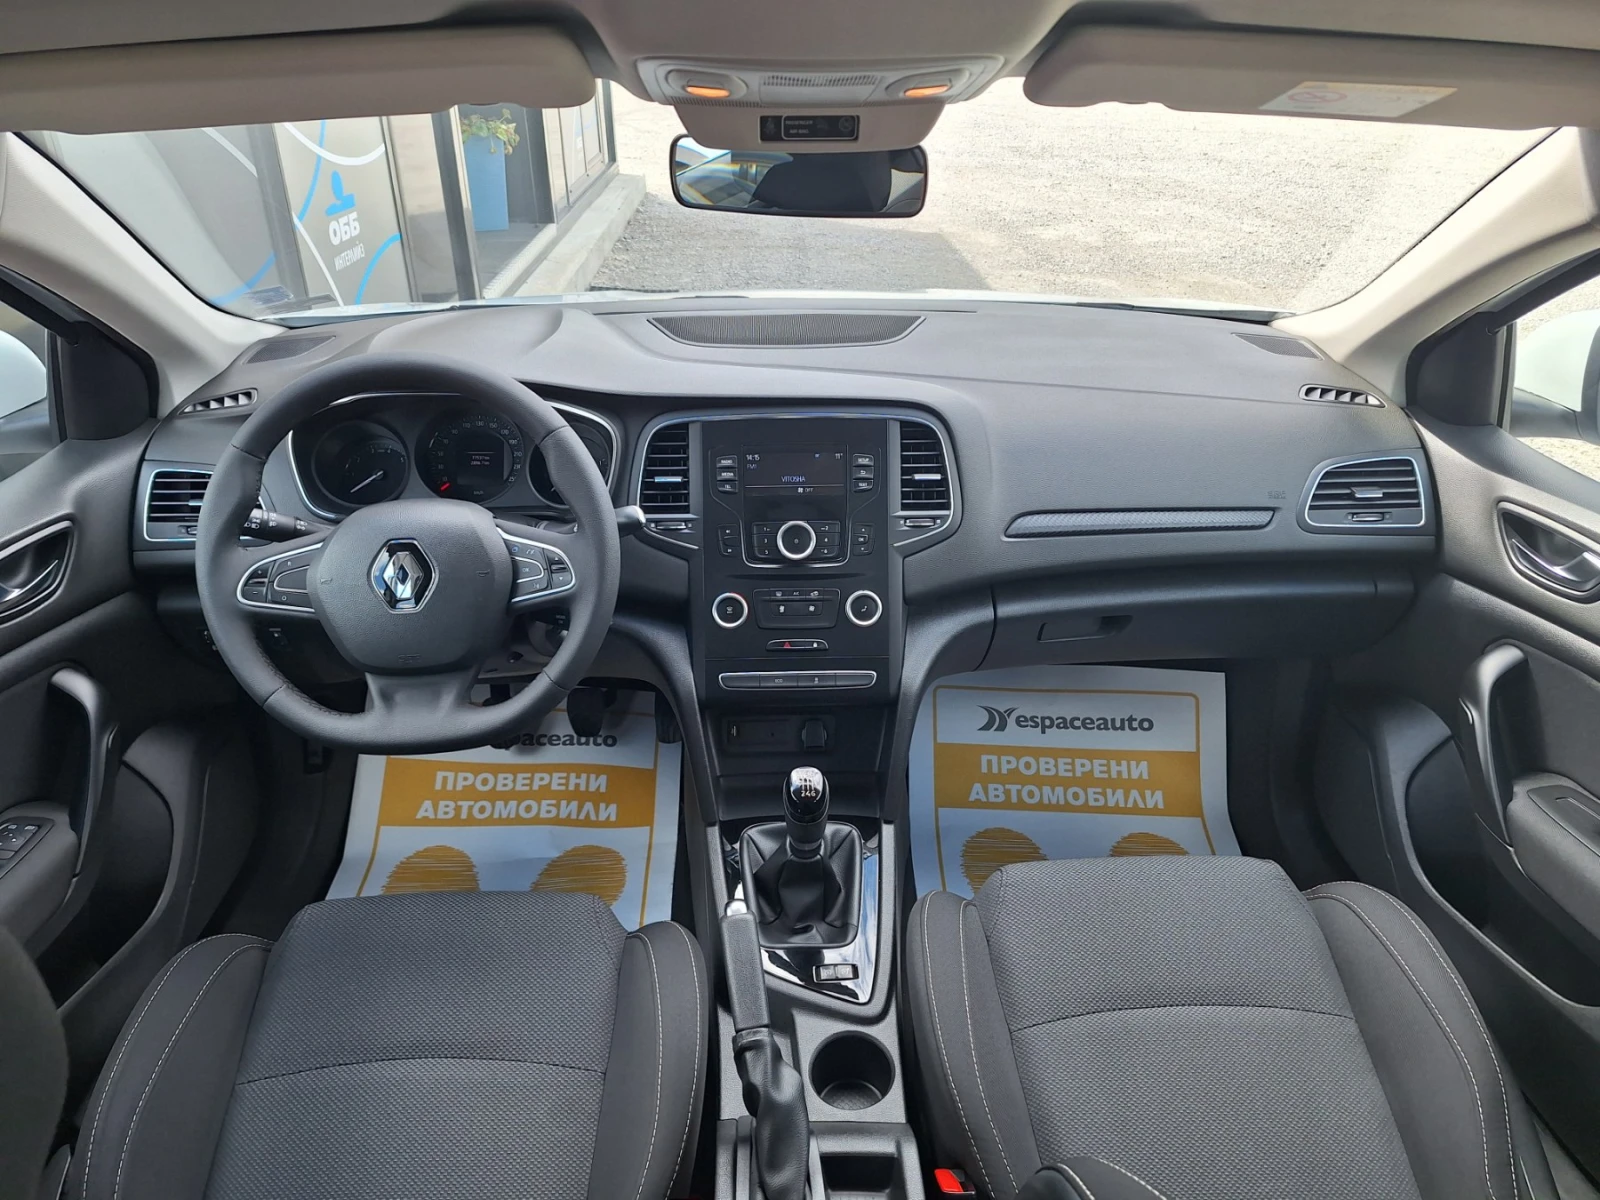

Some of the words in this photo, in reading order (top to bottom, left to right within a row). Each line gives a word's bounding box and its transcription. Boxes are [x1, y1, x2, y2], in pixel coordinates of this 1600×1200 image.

[328, 211, 361, 246] ОББ
[1014, 713, 1154, 734] espaceauto
[980, 754, 1149, 780] ПРОВЕРЕНИ
[434, 771, 608, 793] ПРОВЕРЕНИ
[968, 783, 1164, 809] АВТОМОБИЛИ
[415, 799, 618, 821] АВТОМОБИЛИ
